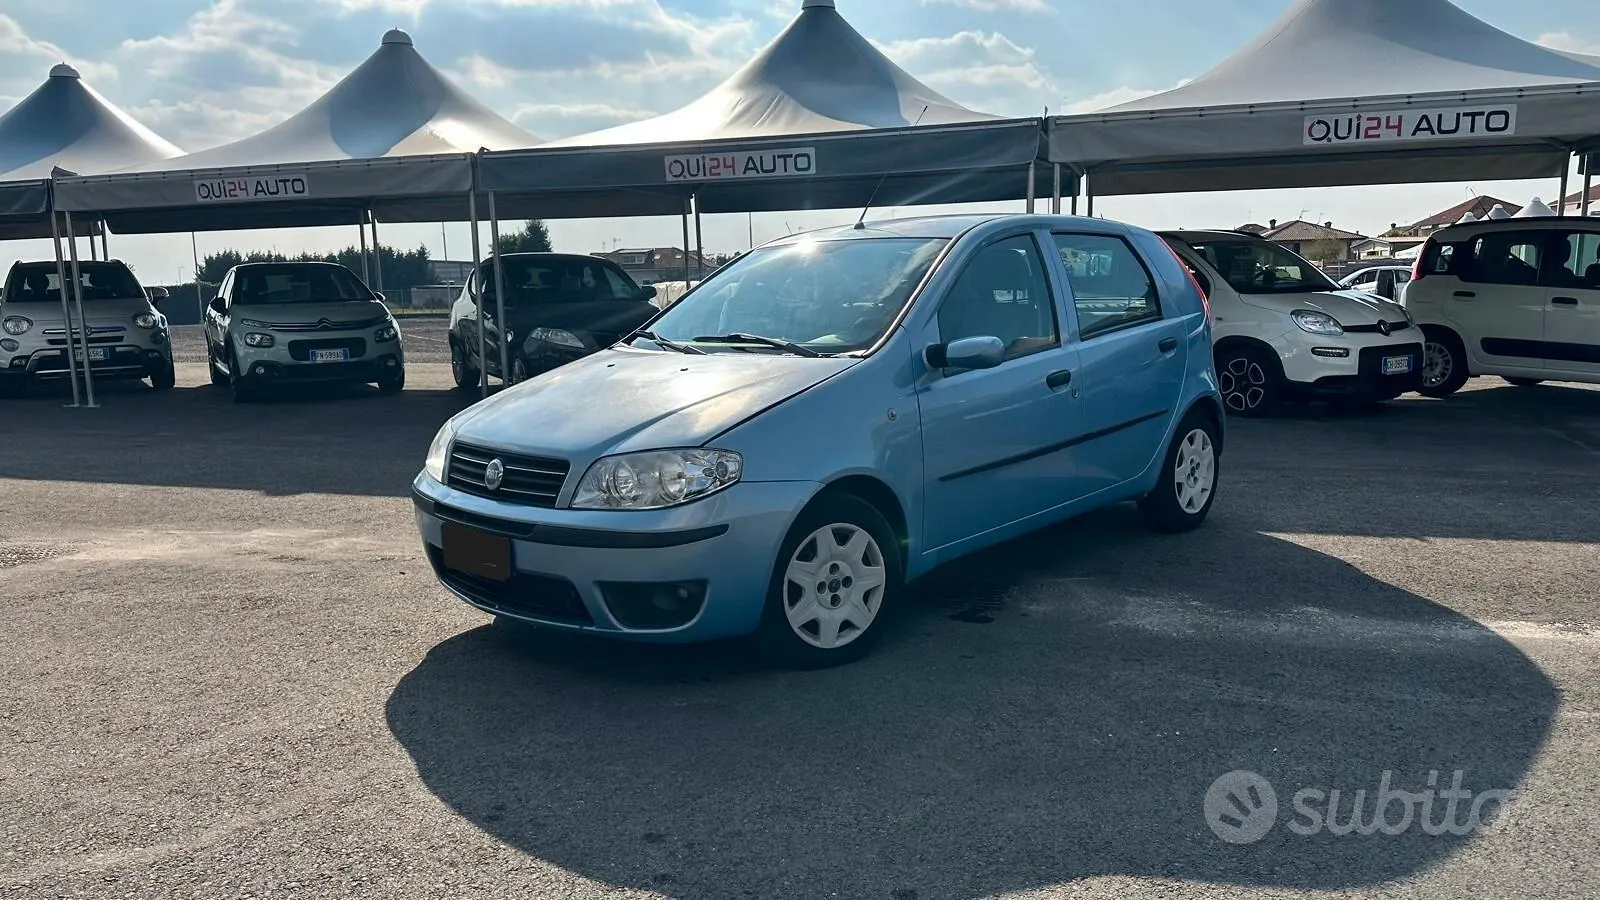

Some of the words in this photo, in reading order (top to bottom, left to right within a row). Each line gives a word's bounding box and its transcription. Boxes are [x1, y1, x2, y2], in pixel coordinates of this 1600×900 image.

[1411, 110, 1510, 137] AUTO
[743, 153, 811, 175] AUTO
[254, 178, 306, 197] AUTO
